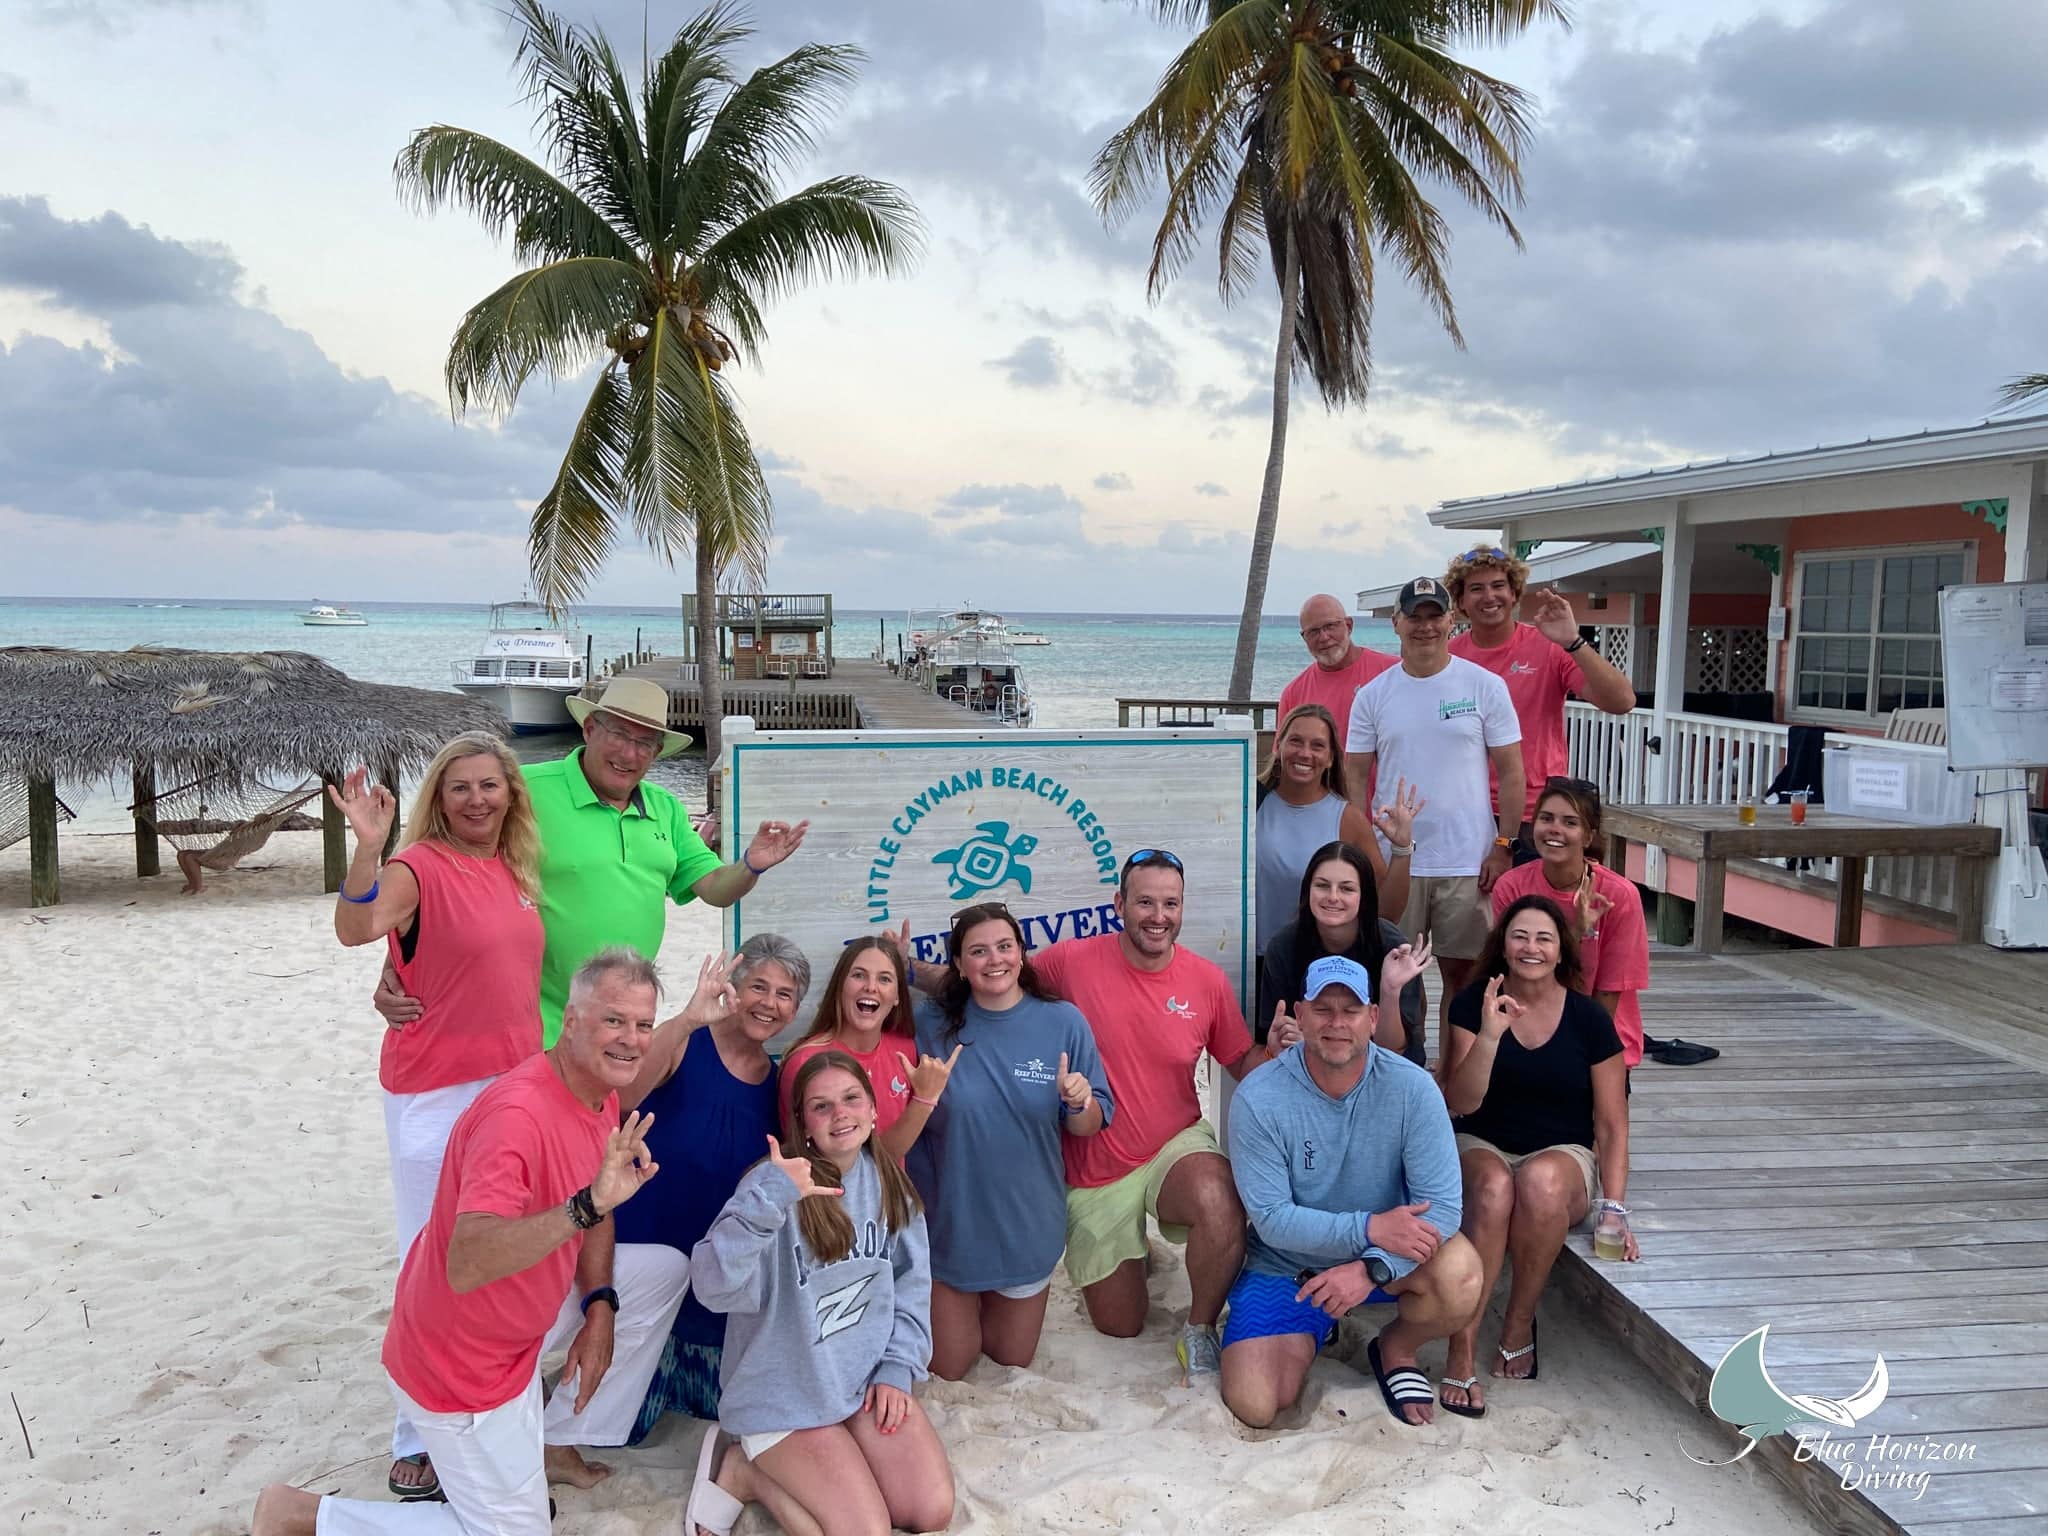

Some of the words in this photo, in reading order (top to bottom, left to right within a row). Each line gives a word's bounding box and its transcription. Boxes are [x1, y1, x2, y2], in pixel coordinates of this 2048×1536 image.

[496, 638, 510, 651] Sea
[514, 638, 556, 648] Dreamer
[868, 836, 900, 923] LITTLE
[892, 768, 983, 835] CAYMAN
[992, 767, 1069, 806] BEACH
[1066, 799, 1119, 885] RESORT
[1018, 903, 1125, 950] IVER
[1031, 1071, 1055, 1080] DIVERS
